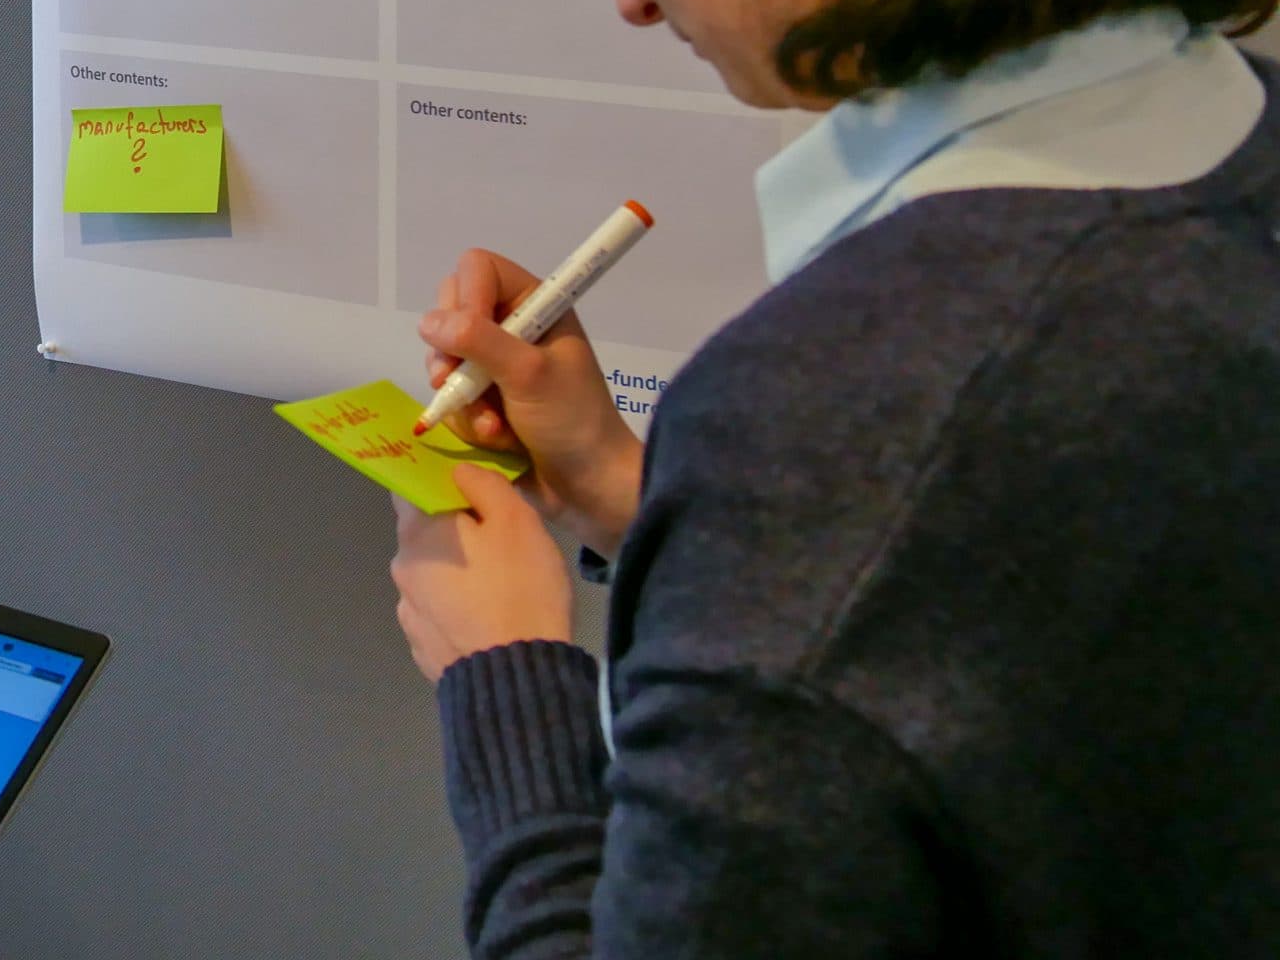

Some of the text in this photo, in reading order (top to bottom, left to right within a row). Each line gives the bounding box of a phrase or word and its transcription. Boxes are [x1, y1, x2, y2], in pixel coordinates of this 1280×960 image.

[71, 66, 168, 89] Other contents:
[410, 100, 527, 126] Other contents:
